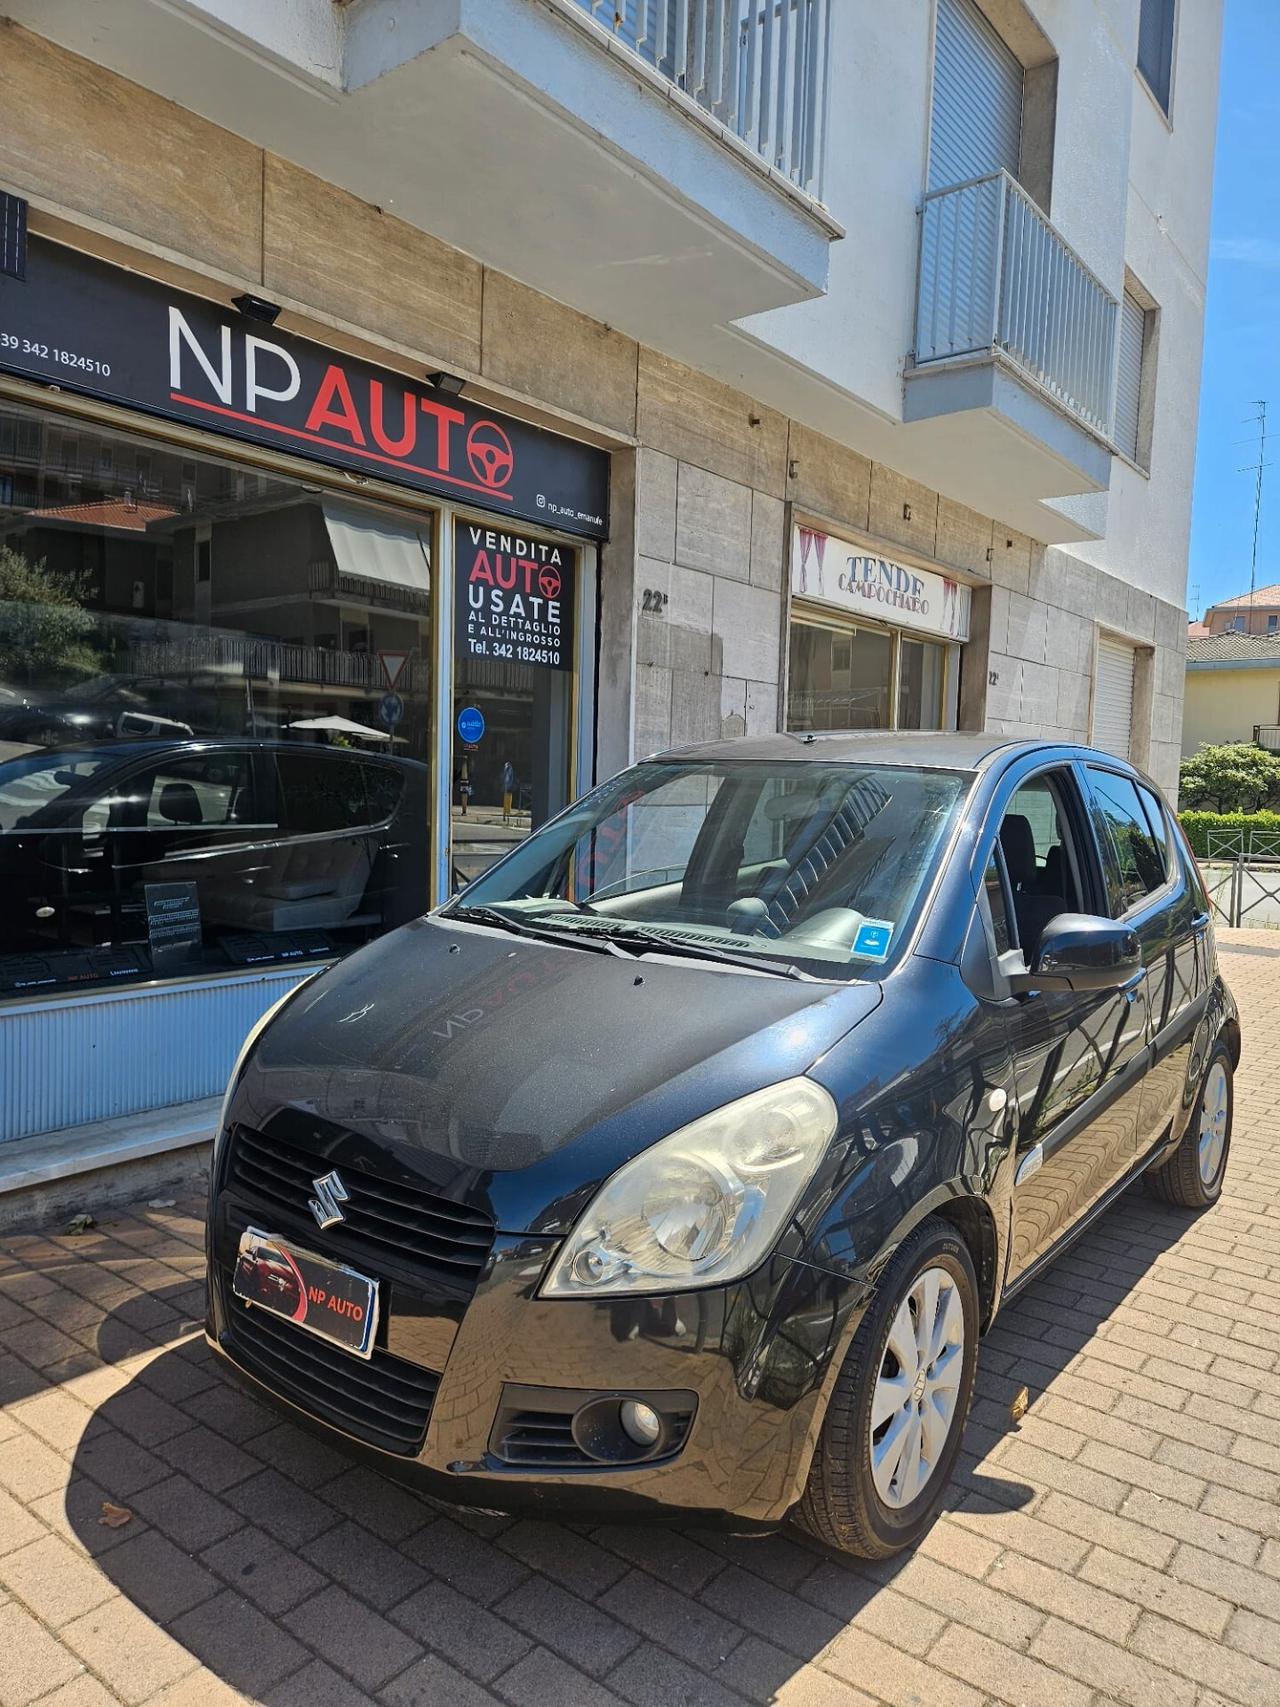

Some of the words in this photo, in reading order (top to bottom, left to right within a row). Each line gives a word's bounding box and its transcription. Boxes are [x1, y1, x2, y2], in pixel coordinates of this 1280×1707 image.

[0, 333, 19, 350] 39
[22, 339, 49, 359] 342
[53, 349, 111, 377] 1824510
[469, 526, 562, 566] VENDITA
[846, 556, 925, 598] TENDE
[468, 584, 561, 624] USATE
[469, 610, 486, 623] AL
[492, 614, 561, 636] DETTAGLIO
[468, 624, 475, 634] E
[480, 626, 561, 648] ALL'INGROSSO
[468, 638, 490, 655] Tel.
[493, 642, 513, 659] 342
[516, 646, 560, 665] 1824510
[308, 1286, 326, 1305] NP
[327, 1297, 363, 1322] AUTO
